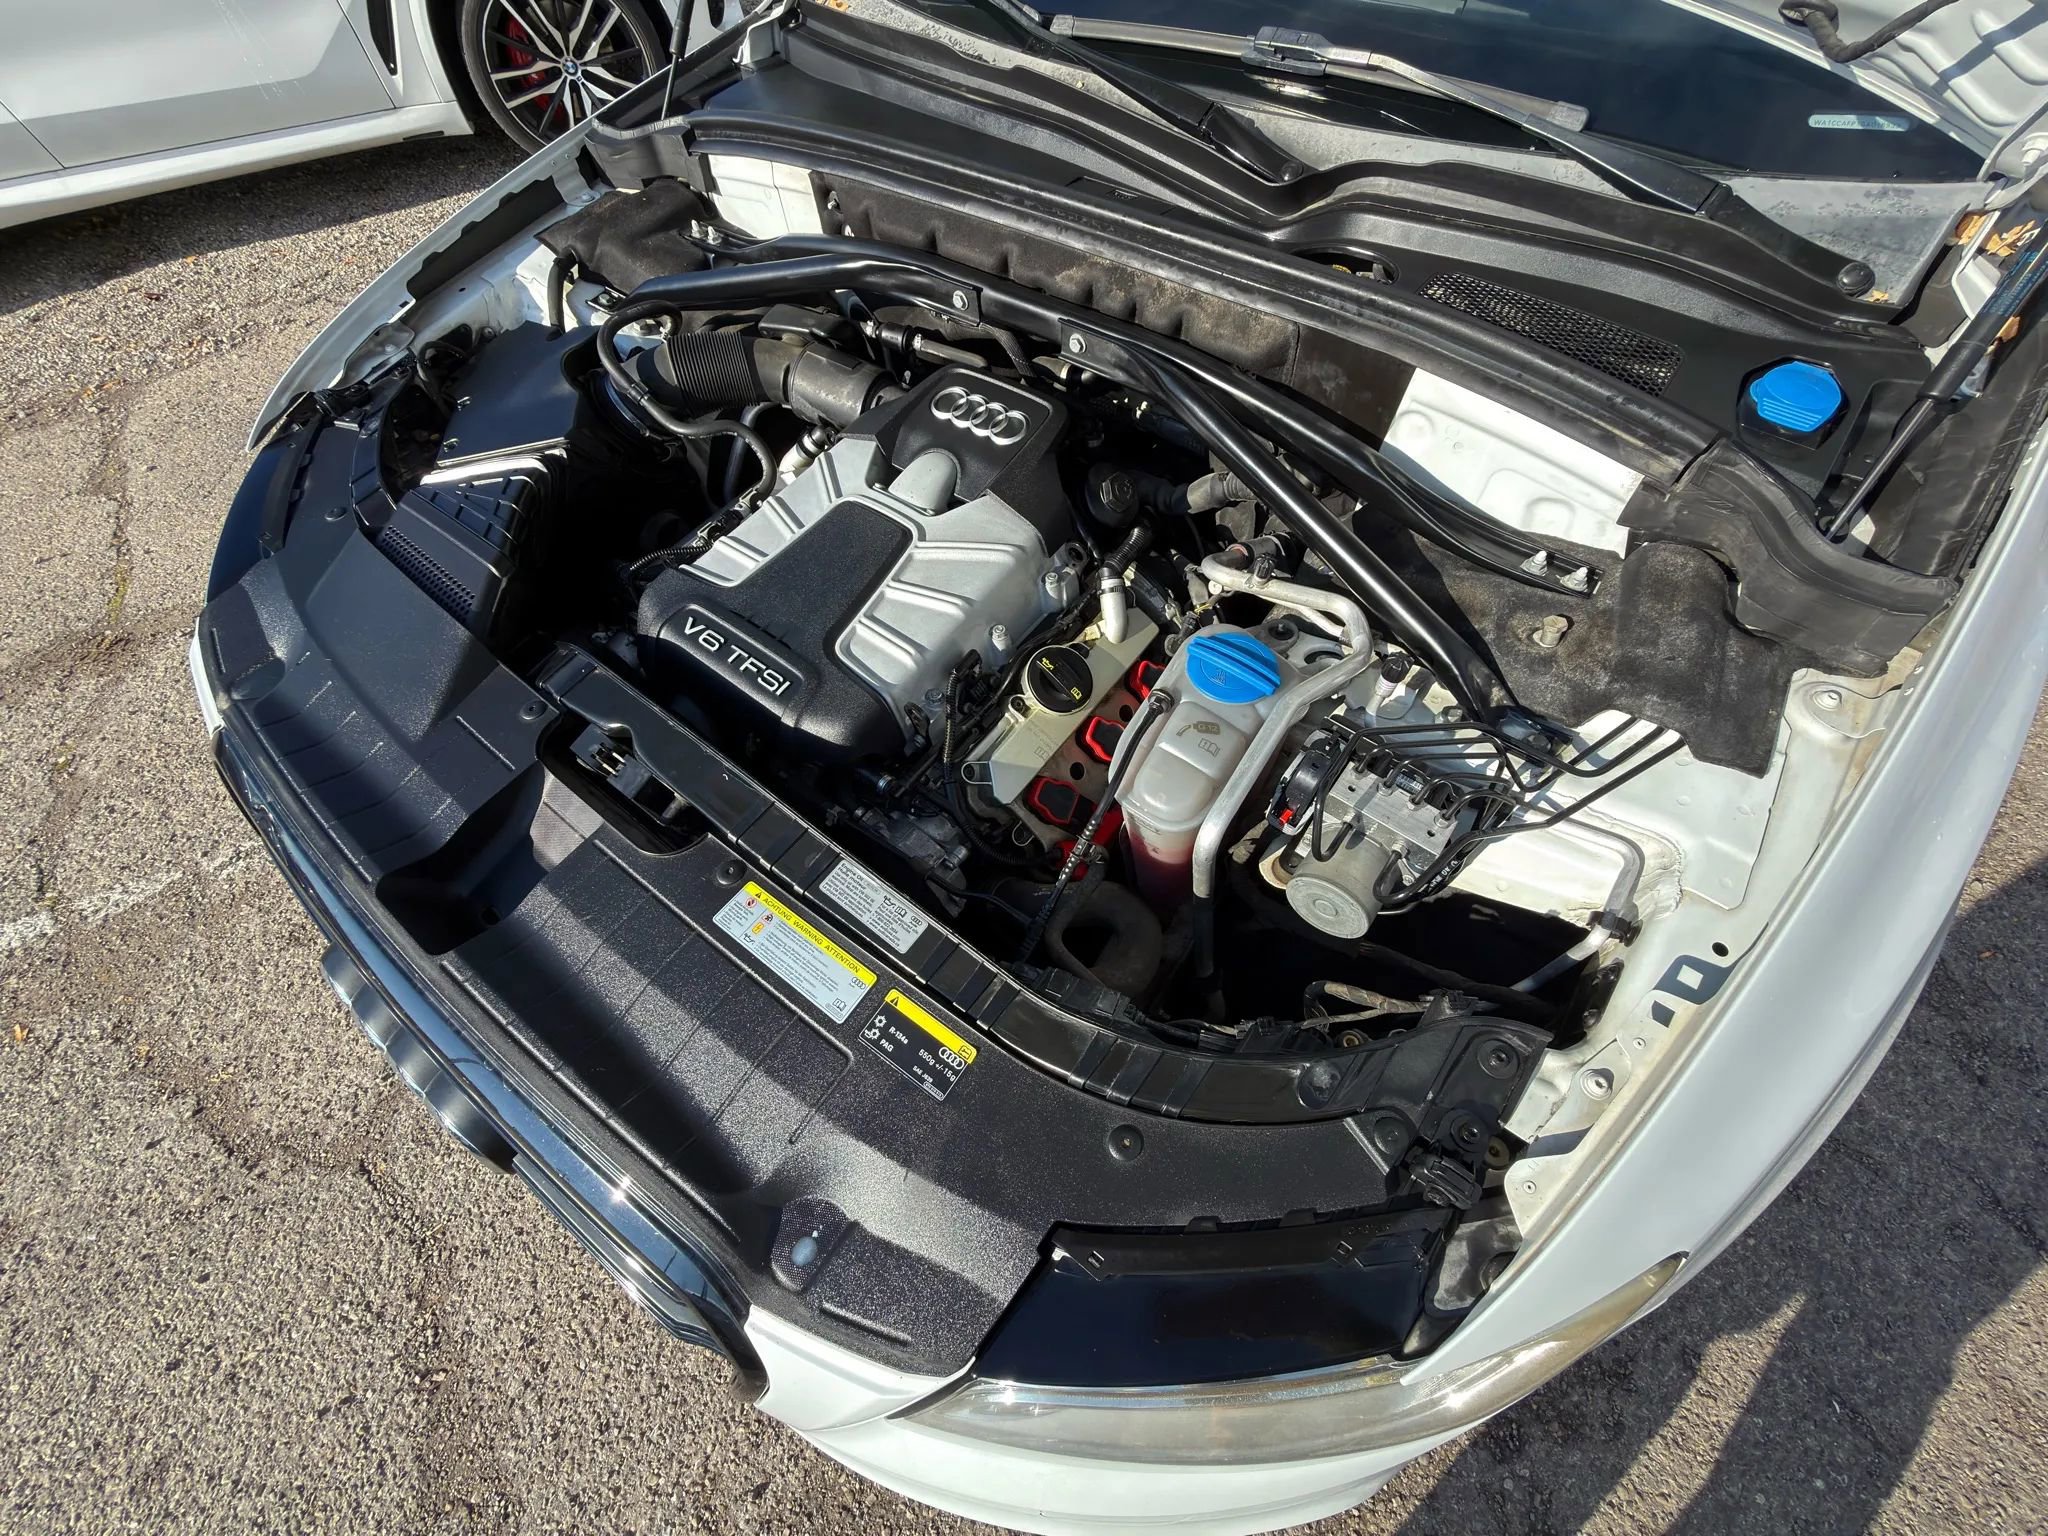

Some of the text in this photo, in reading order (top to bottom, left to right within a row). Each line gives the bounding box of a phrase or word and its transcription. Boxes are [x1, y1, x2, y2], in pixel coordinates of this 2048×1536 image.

[684, 616, 791, 696] V6 TFSI
[762, 897, 792, 921] ACHTUNG
[792, 920, 823, 945] WARNING
[823, 944, 860, 973] ATTENTION
[879, 1038, 894, 1052] PAG
